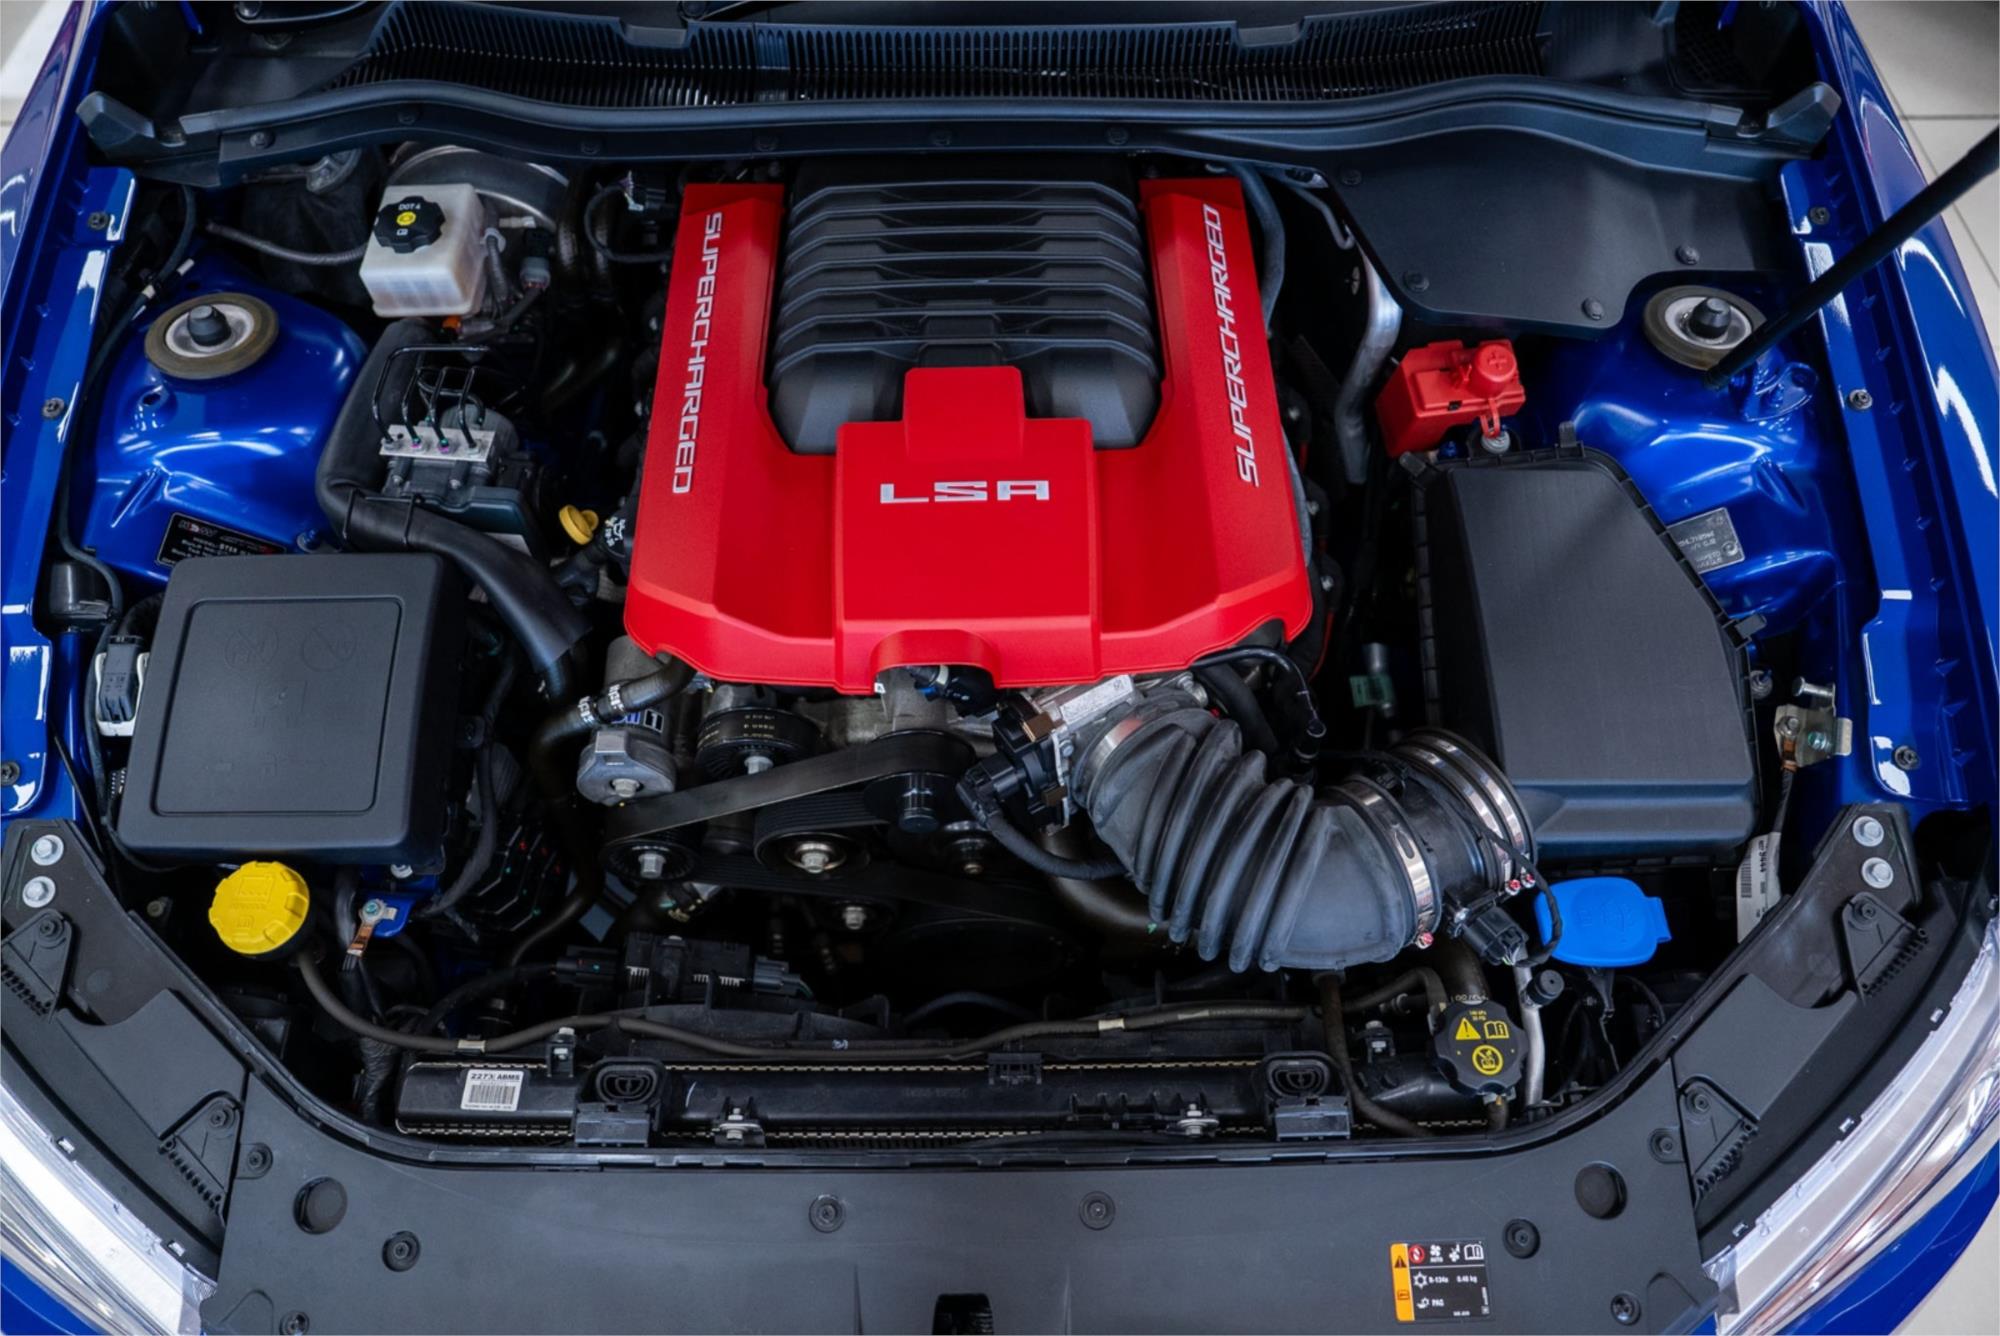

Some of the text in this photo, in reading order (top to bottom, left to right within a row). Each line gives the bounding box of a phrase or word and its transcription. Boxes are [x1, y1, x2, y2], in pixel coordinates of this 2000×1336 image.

[672, 212, 722, 493] SUPERCHARGED
[1203, 203, 1259, 487] SUPERCHARGED
[880, 480, 1050, 504] LSA
